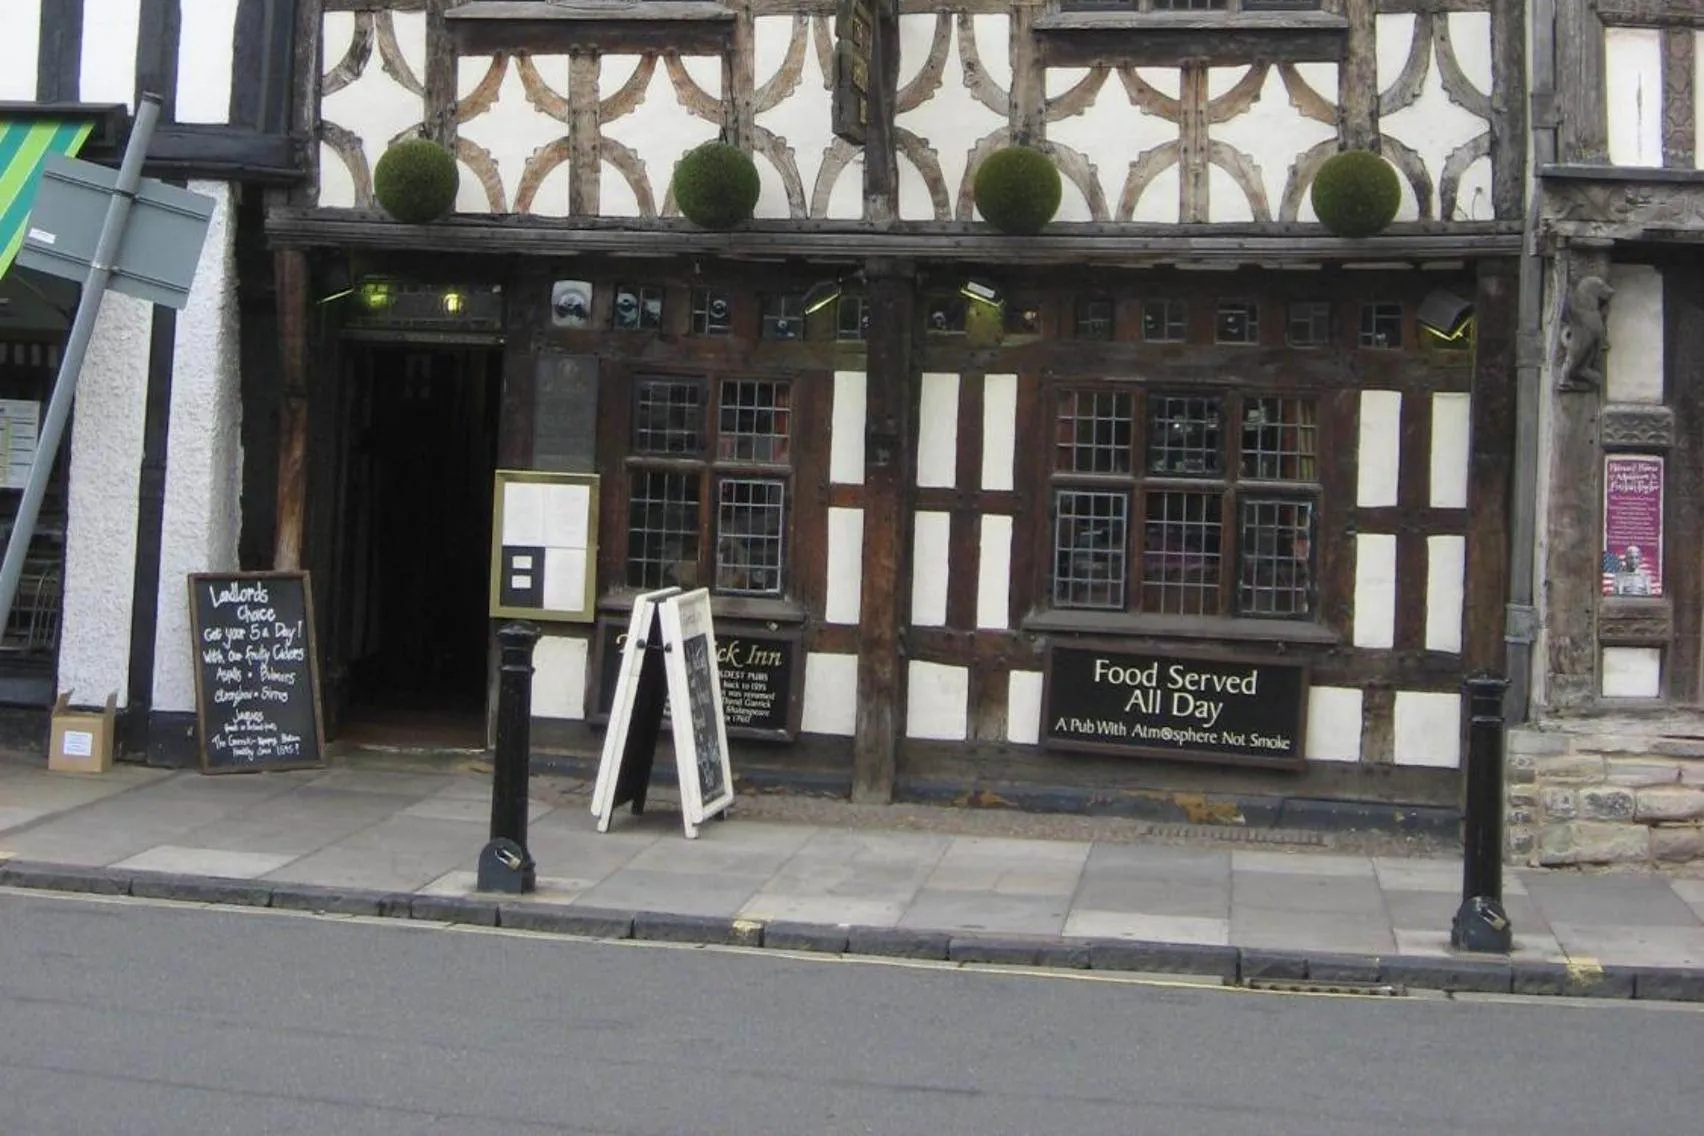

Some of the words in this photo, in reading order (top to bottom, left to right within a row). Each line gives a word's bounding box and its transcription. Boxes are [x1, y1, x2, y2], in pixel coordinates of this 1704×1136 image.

[209, 581, 269, 608] Landlords
[249, 624, 261, 640] 5
[745, 645, 782, 666] Inn
[719, 670, 745, 680] LDEST
[1094, 659, 1158, 688] Food
[1167, 665, 1258, 695] Served
[1125, 689, 1161, 714] All
[1172, 692, 1223, 728] Day
[1055, 717, 1067, 732] A
[1070, 719, 1095, 734] Pub
[1097, 721, 1127, 736] With
[1222, 732, 1246, 746] Not
[1250, 733, 1290, 750] Smoke
